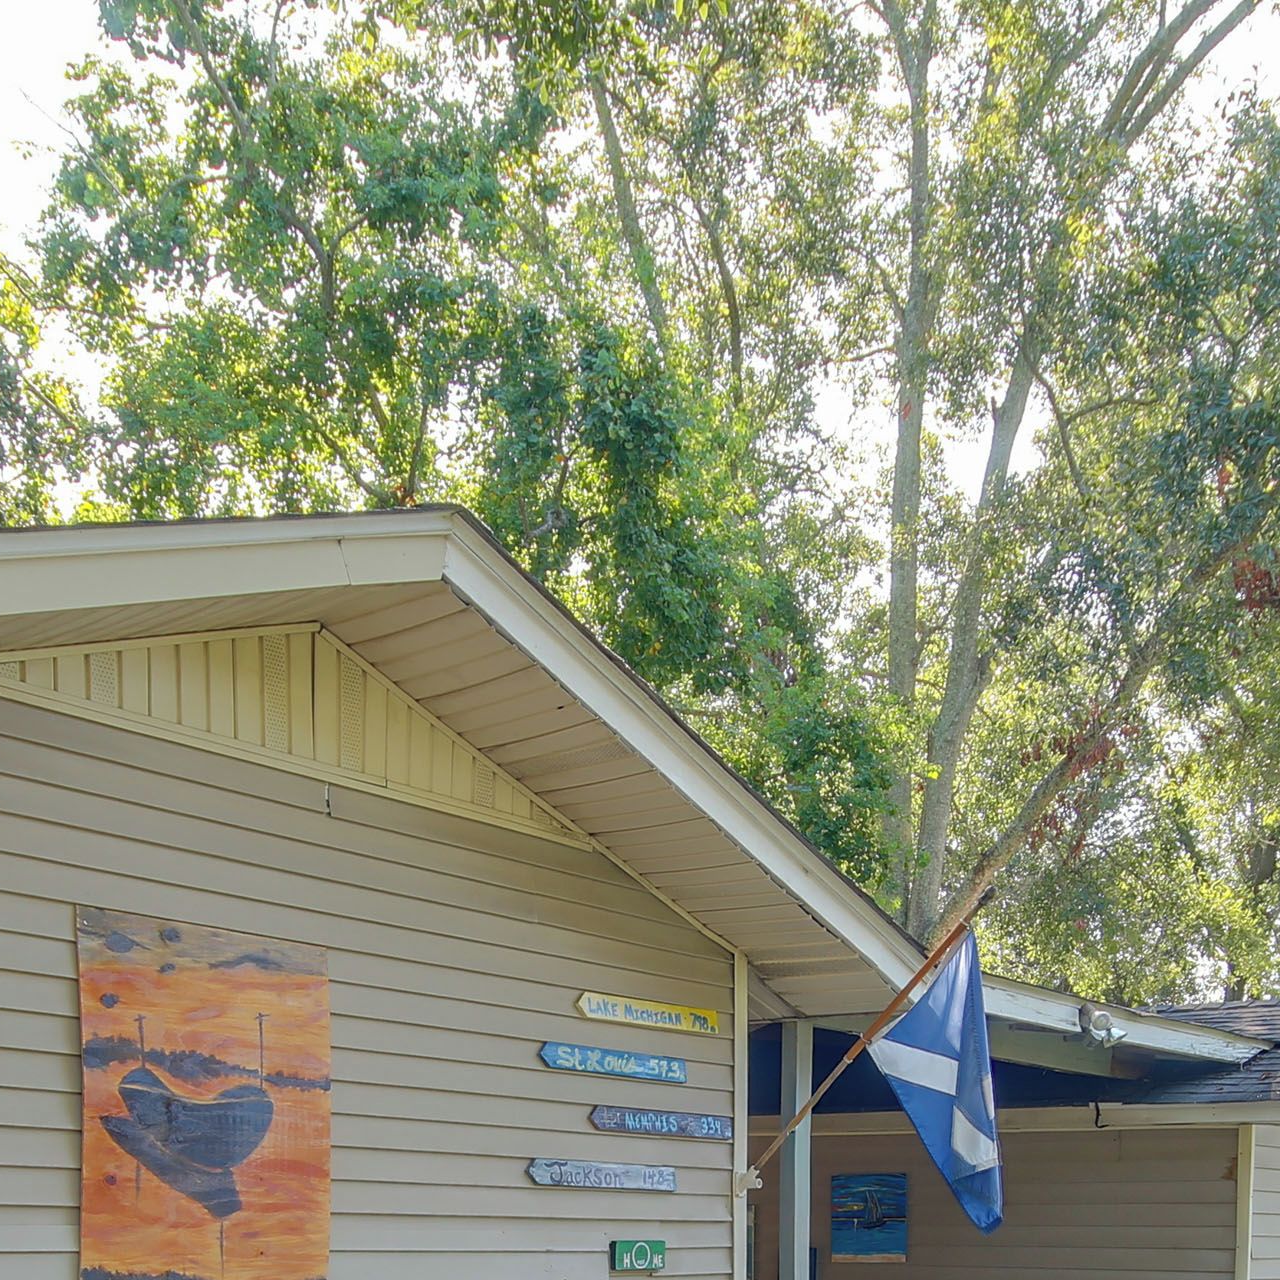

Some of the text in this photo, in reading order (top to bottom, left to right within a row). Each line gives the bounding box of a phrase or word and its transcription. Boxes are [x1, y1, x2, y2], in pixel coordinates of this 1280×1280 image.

[587, 997, 619, 1017] LAKE
[623, 1003, 682, 1026] MICHIGAN
[689, 1012, 709, 1031] 798
[556, 1046, 585, 1070] St
[586, 1048, 642, 1074] Louis
[648, 1058, 680, 1078] 573
[624, 1112, 678, 1132] MEMPHIS
[543, 1160, 624, 1187] Jackson
[623, 1241, 664, 1270] HOME
